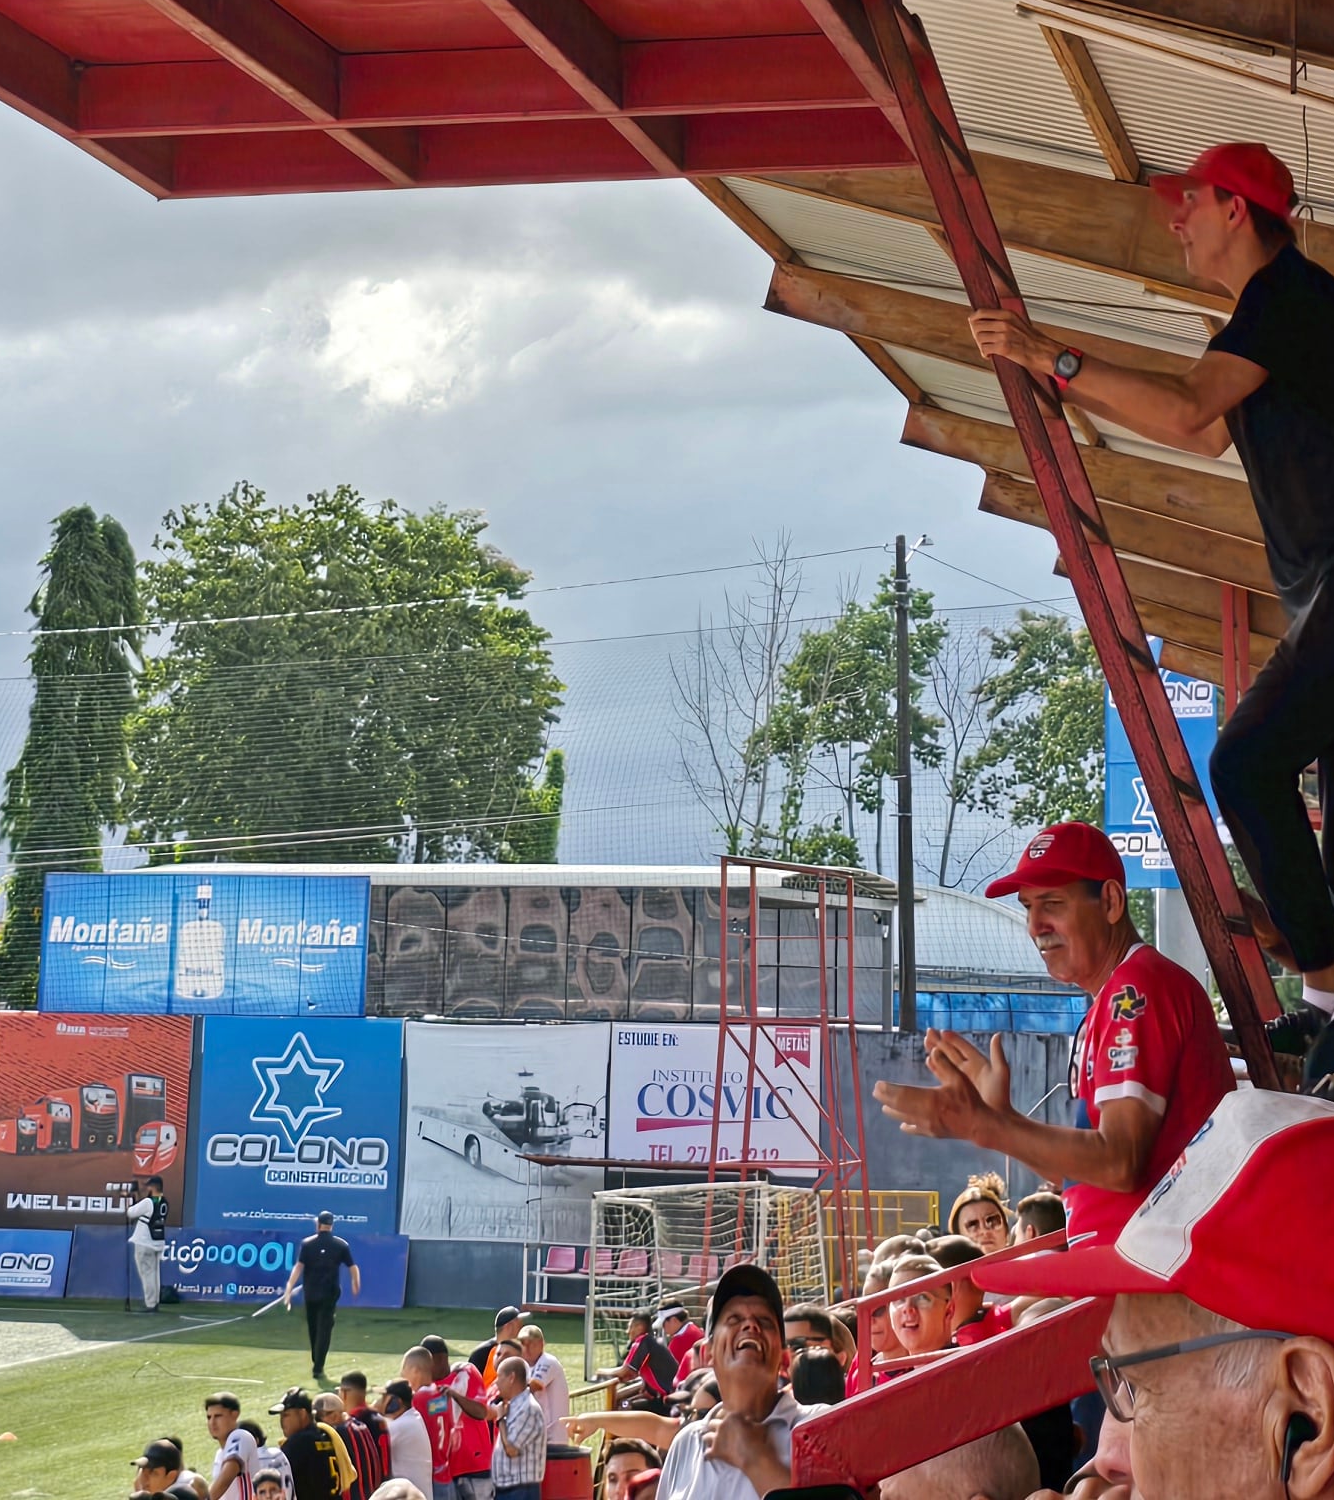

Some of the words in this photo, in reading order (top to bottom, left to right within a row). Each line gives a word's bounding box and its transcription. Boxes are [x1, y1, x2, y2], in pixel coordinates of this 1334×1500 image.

[49, 916, 169, 942] Montaña
[237, 919, 359, 946] Montaña
[619, 1031, 658, 1046] ESTUDIE
[777, 1035, 809, 1052] METAS
[637, 1083, 793, 1119] COSVIC
[208, 1136, 386, 1169] COLONO
